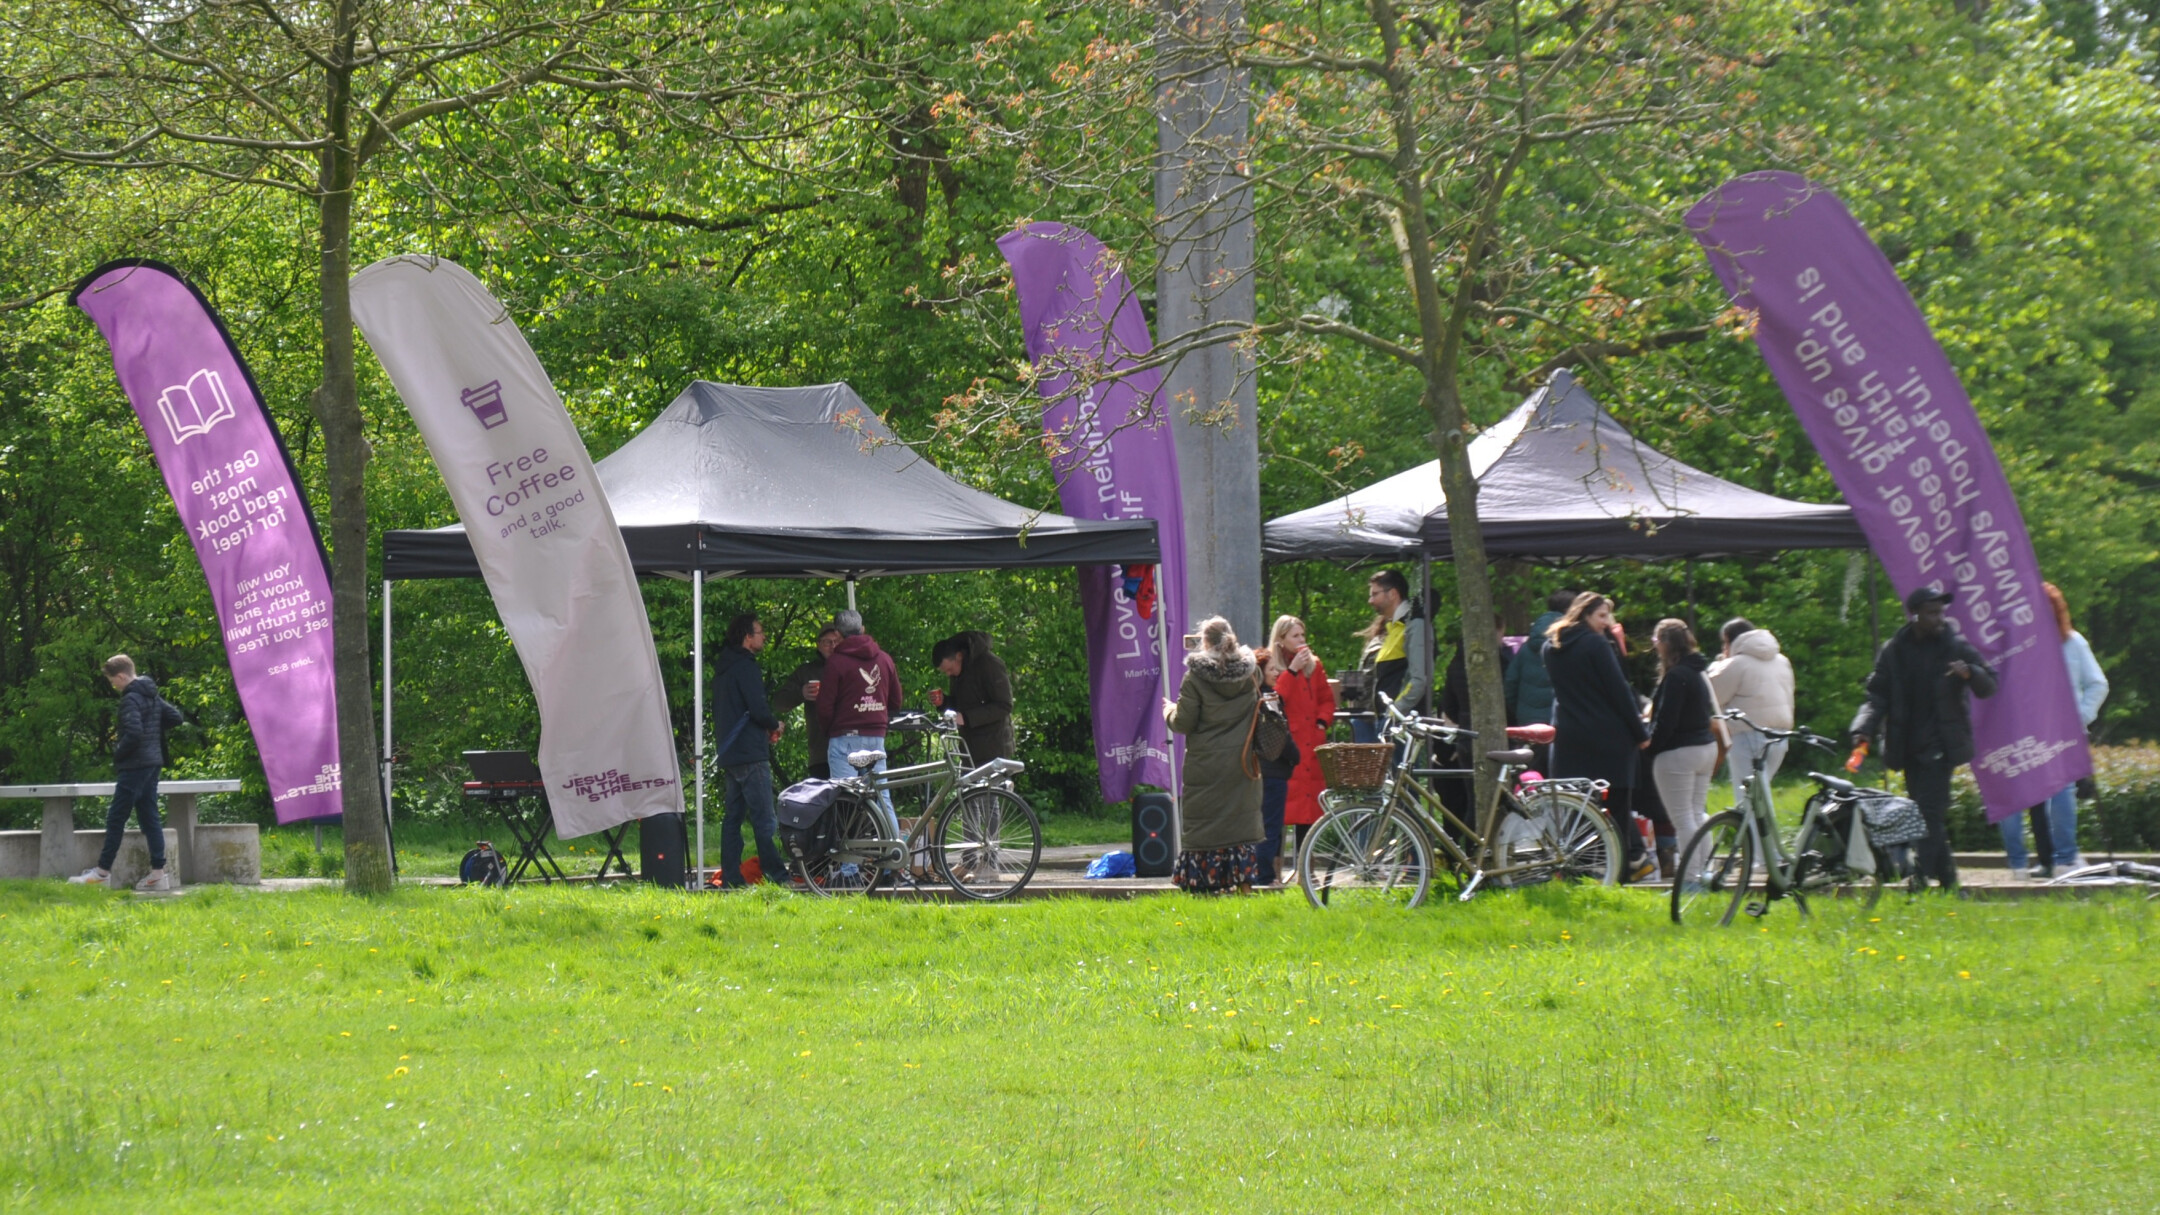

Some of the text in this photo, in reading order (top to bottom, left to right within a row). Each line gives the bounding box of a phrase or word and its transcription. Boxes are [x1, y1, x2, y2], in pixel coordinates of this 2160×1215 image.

[1795, 266, 1826, 304] is
[1809, 301, 1867, 366] and
[1856, 370, 1917, 462] faith
[1895, 365, 1981, 508] hopeful.
[486, 448, 548, 486] Free
[1794, 328, 1936, 574] never gives up,
[486, 465, 575, 516] Coffee
[500, 489, 585, 538] and a good
[1908, 456, 1958, 546] loses
[530, 518, 566, 539] talk.
[1970, 510, 2035, 626] always
[1113, 587, 1141, 659] Love
[1944, 552, 2005, 645] never
[1124, 668, 1150, 679] Mark
[562, 769, 618, 789] JESUS
[576, 774, 630, 796] IN THE
